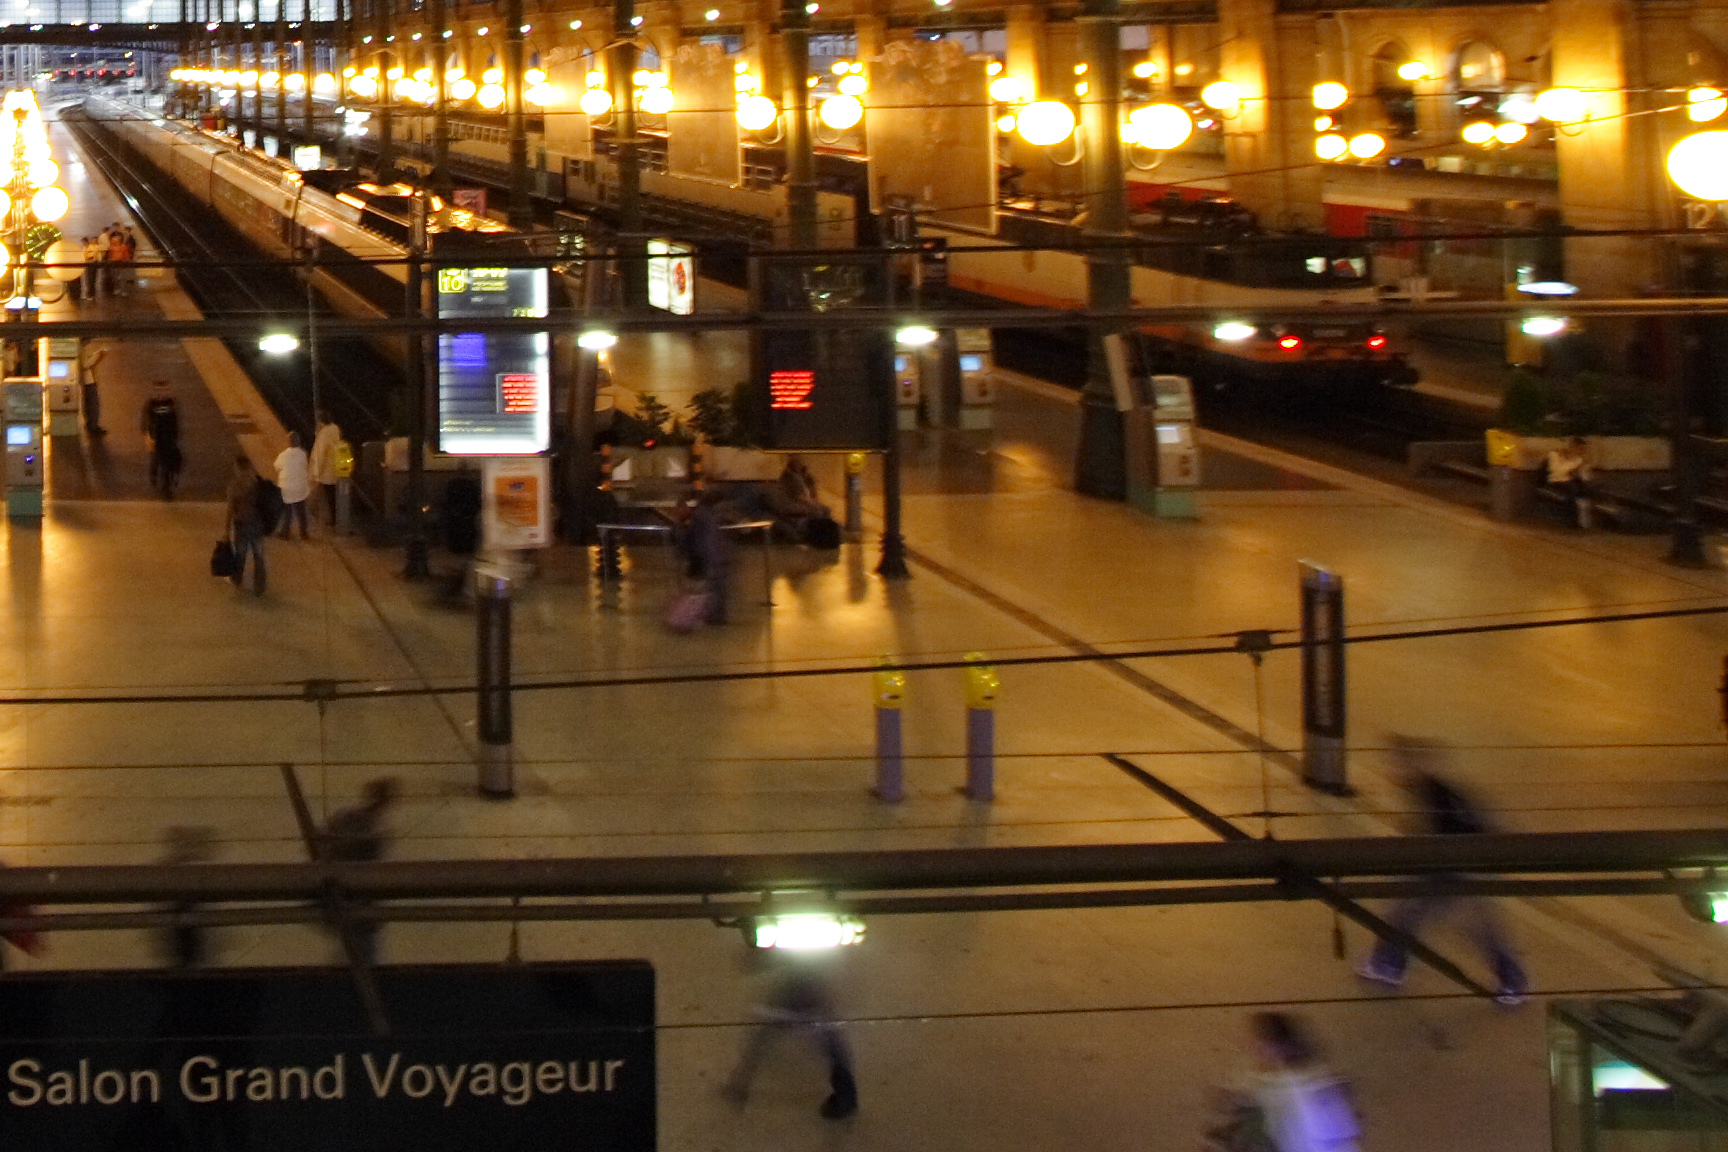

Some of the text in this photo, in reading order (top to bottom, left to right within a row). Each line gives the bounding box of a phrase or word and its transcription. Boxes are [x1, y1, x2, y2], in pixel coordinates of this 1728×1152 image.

[441, 275, 464, 292] 10
[7, 1052, 625, 1108] Salon Grand Voyageur
